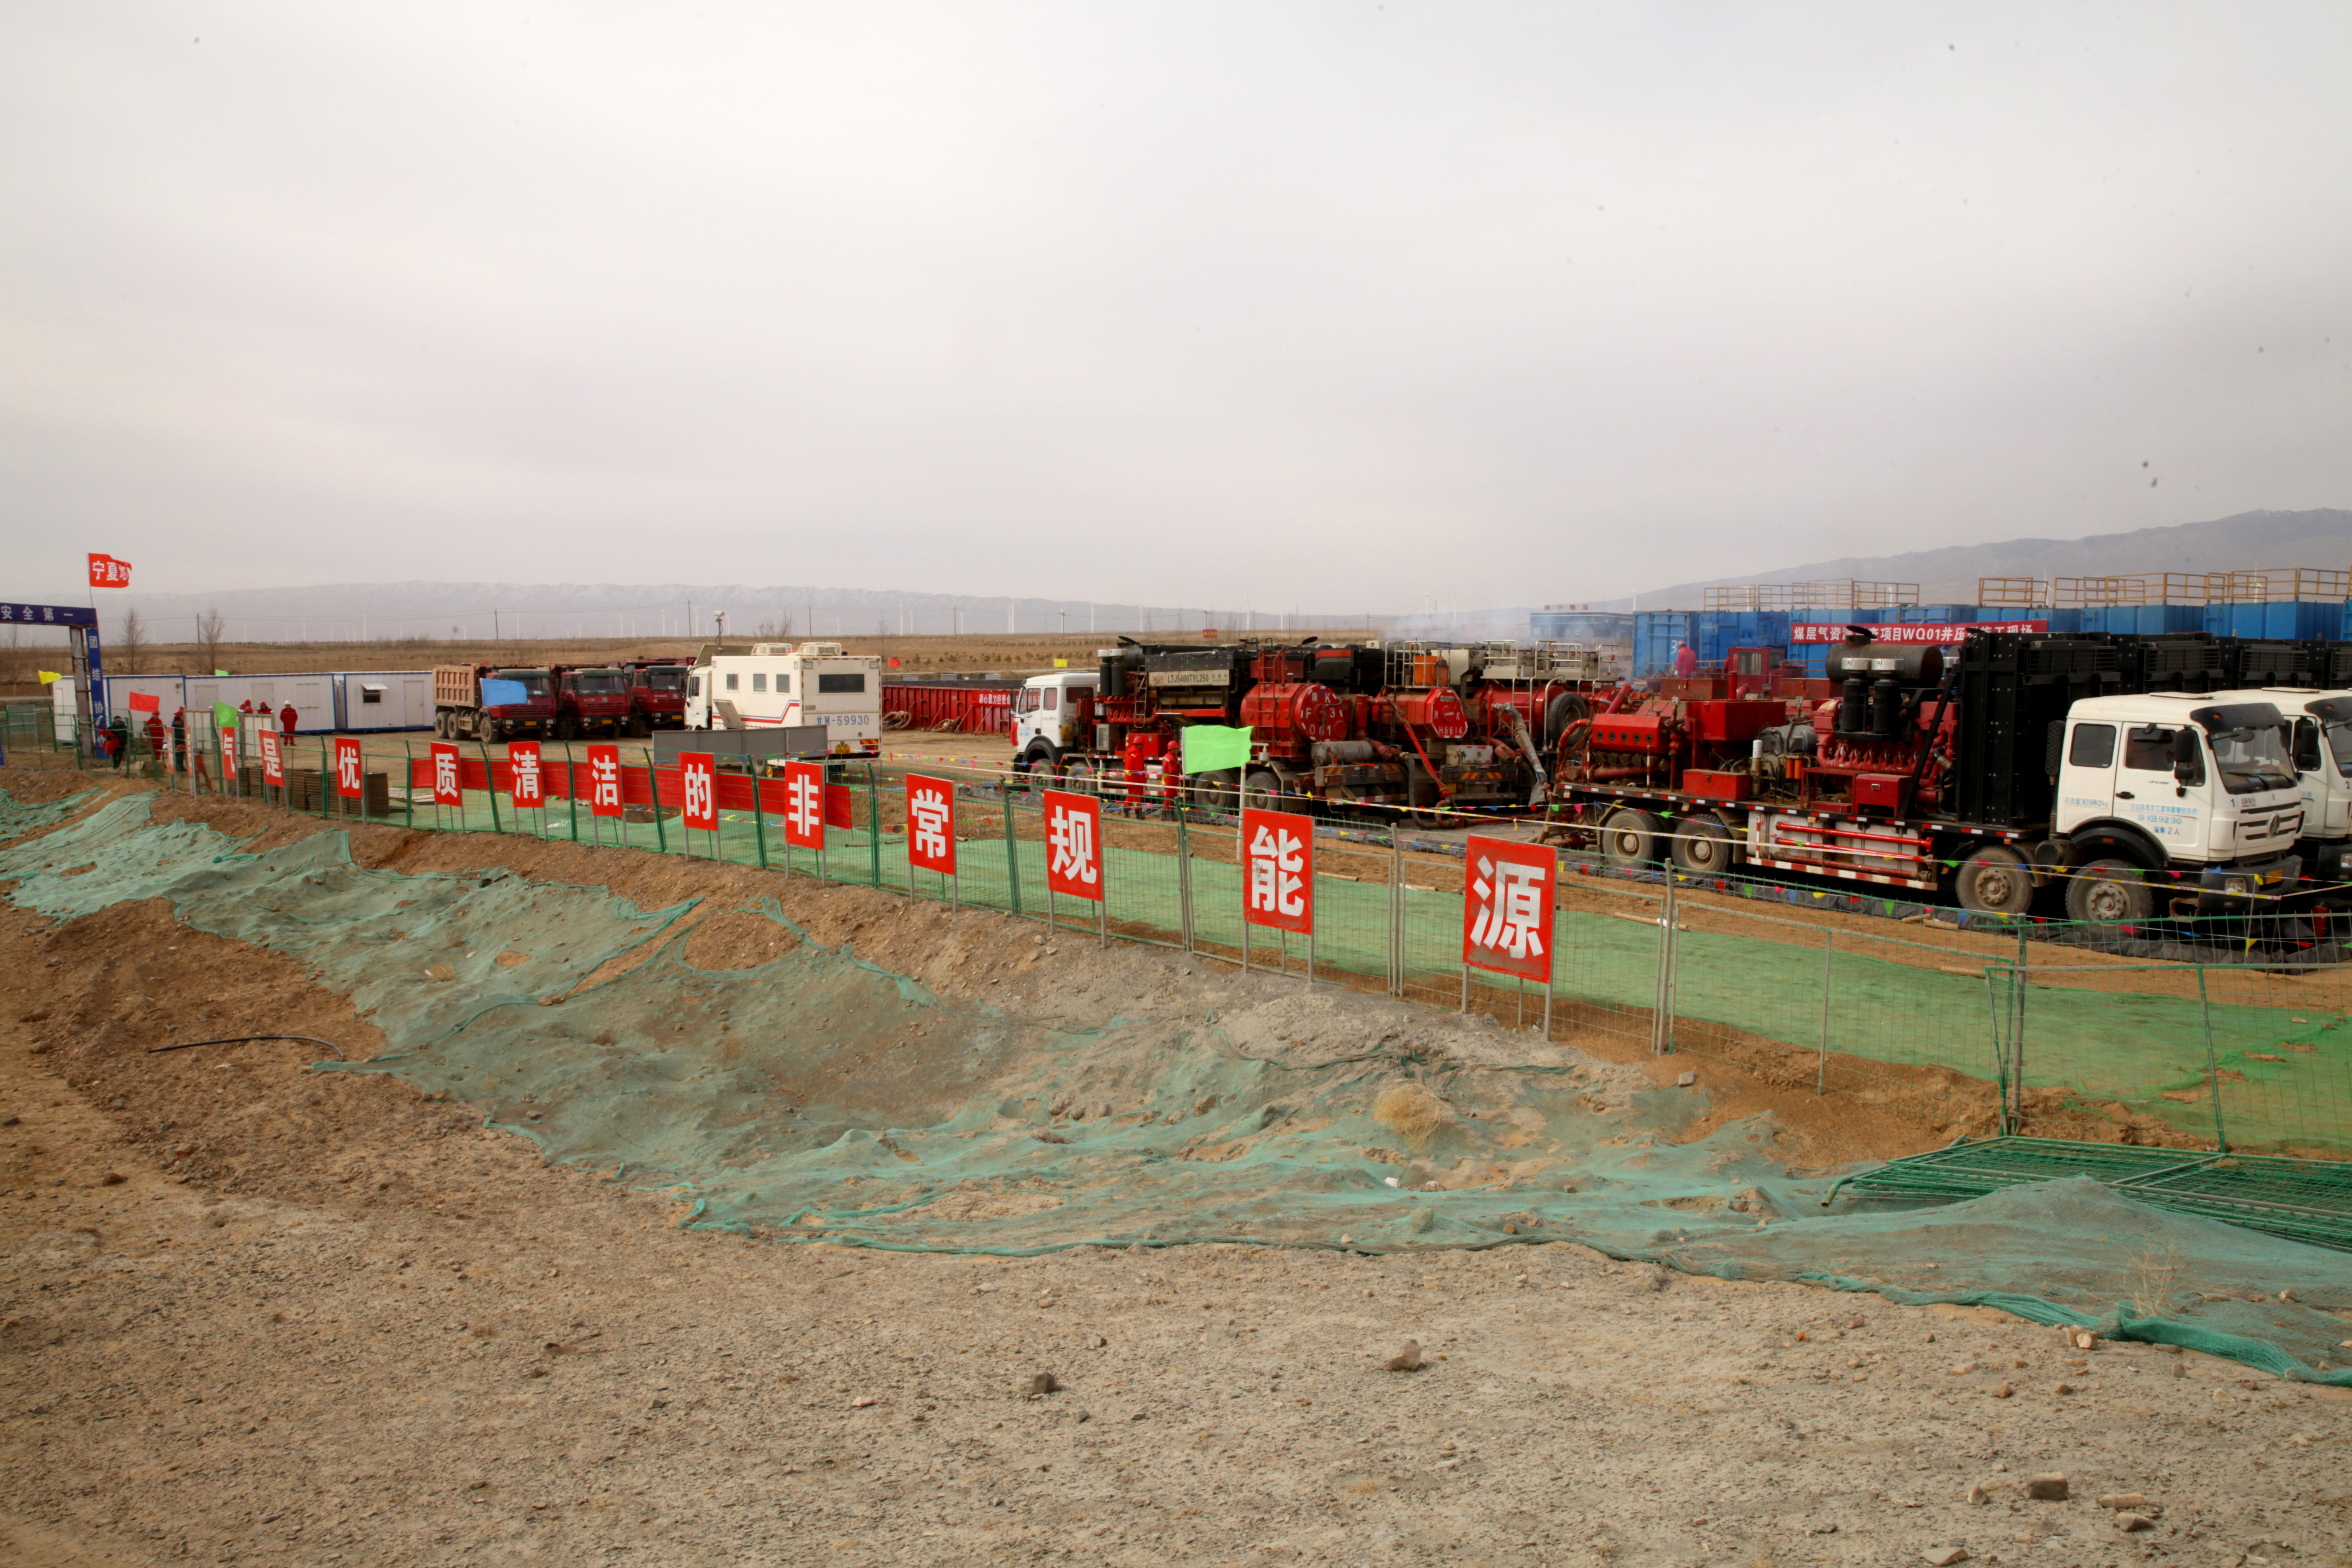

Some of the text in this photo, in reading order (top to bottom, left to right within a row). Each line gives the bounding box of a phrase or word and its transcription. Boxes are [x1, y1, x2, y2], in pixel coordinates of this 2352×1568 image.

[0, 604, 74, 622] 安全第一
[1168, 674, 1209, 683] LTJ5400TYL250
[263, 738, 281, 778] 是
[339, 747, 360, 789] 优
[436, 753, 458, 797] 质
[512, 750, 539, 799] 清
[592, 755, 618, 806] 洁
[685, 763, 712, 820] 的
[789, 774, 819, 837] 非
[2231, 798, 2235, 807] 1
[2345, 781, 2350, 789] 2
[911, 789, 949, 859] 常
[1050, 805, 1097, 884] 规
[1250, 825, 1304, 917] 能
[1470, 855, 1545, 959] 源
